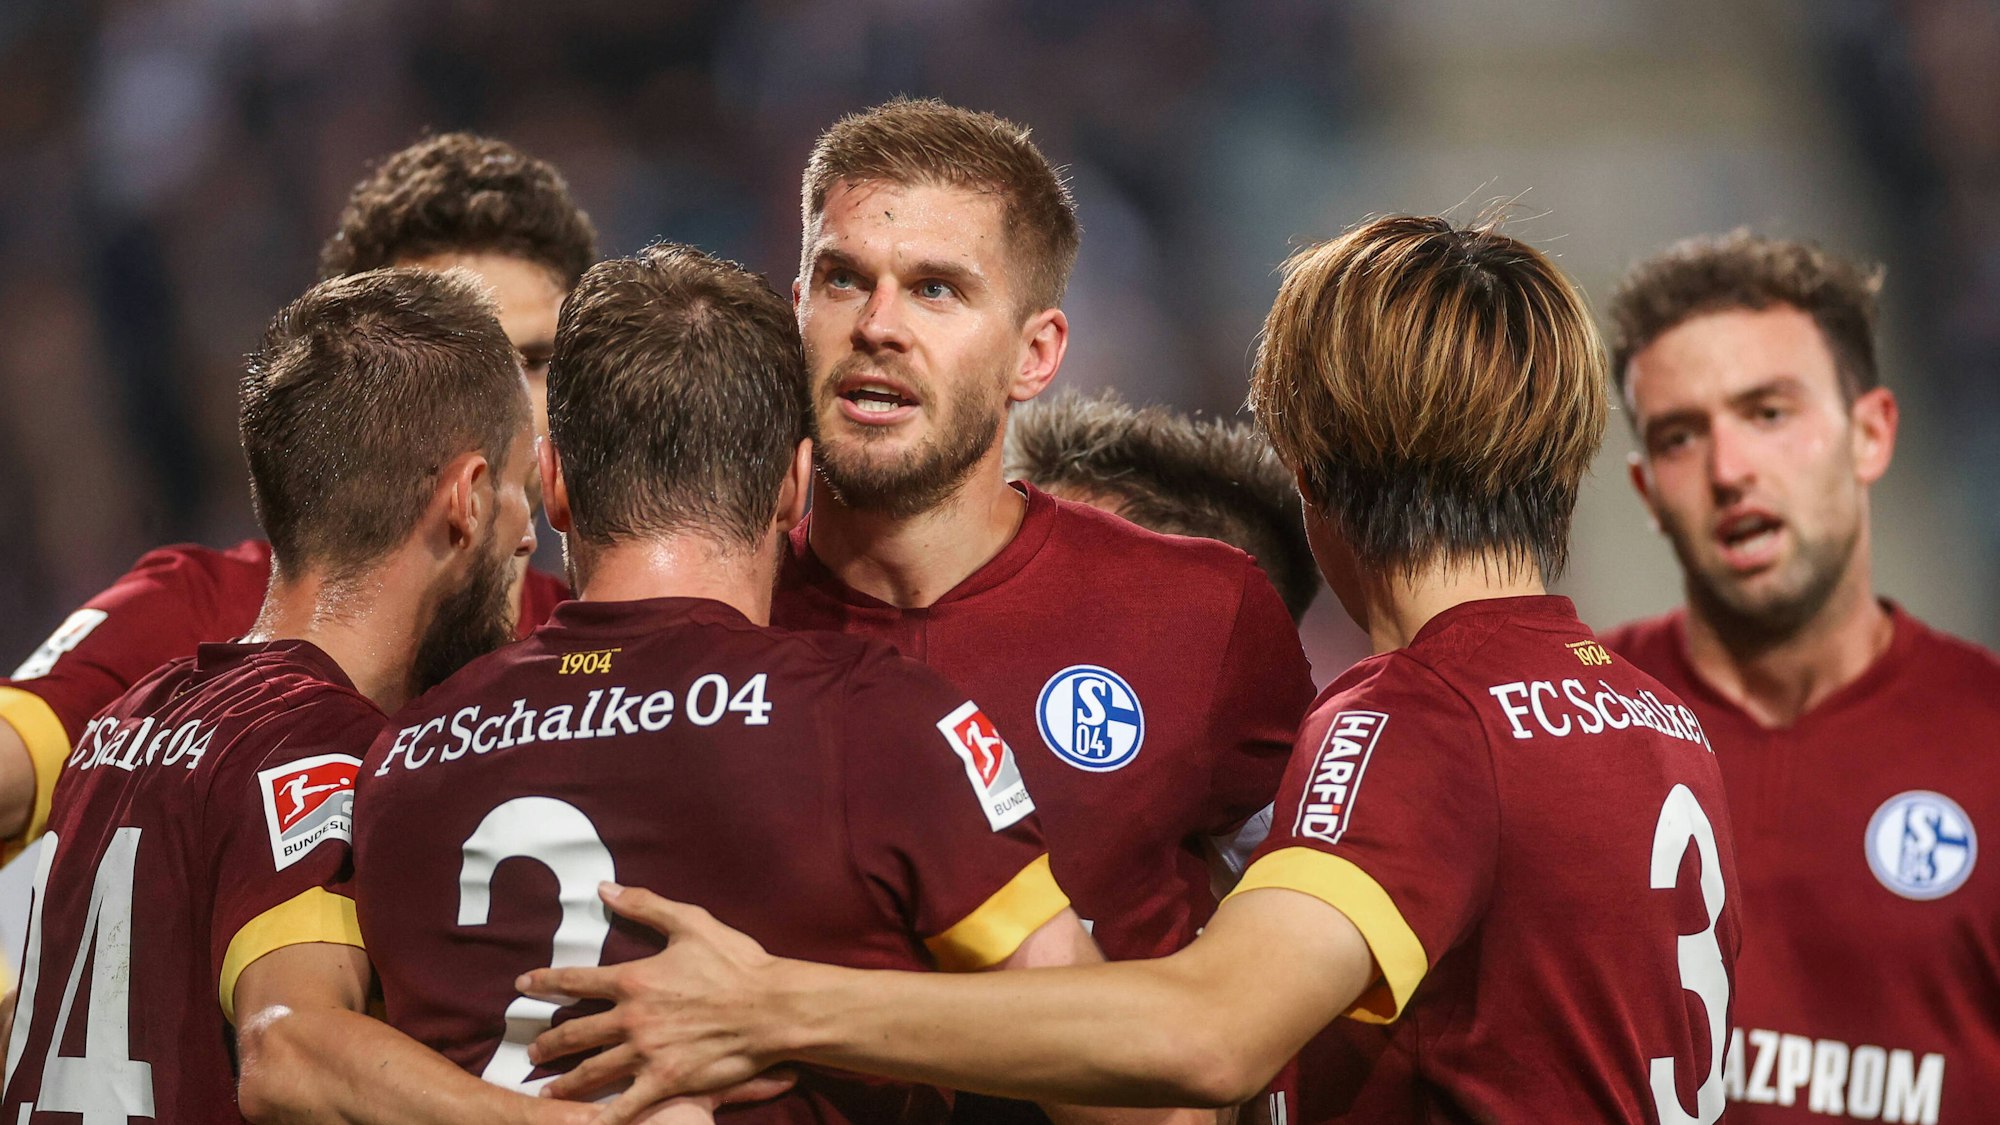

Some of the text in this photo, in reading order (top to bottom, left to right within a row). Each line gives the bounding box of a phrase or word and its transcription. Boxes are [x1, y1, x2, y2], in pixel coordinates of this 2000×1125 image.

[558, 652, 612, 675] 1904
[1573, 644, 1612, 666] 1904
[439, 686, 675, 763] Schalke
[685, 672, 773, 726] 04
[162, 718, 219, 770] 04
[1075, 723, 1106, 758] 04
[284, 820, 351, 856] BUNDESLI
[457, 796, 620, 1104] 2
[1649, 783, 1730, 1125] 3
